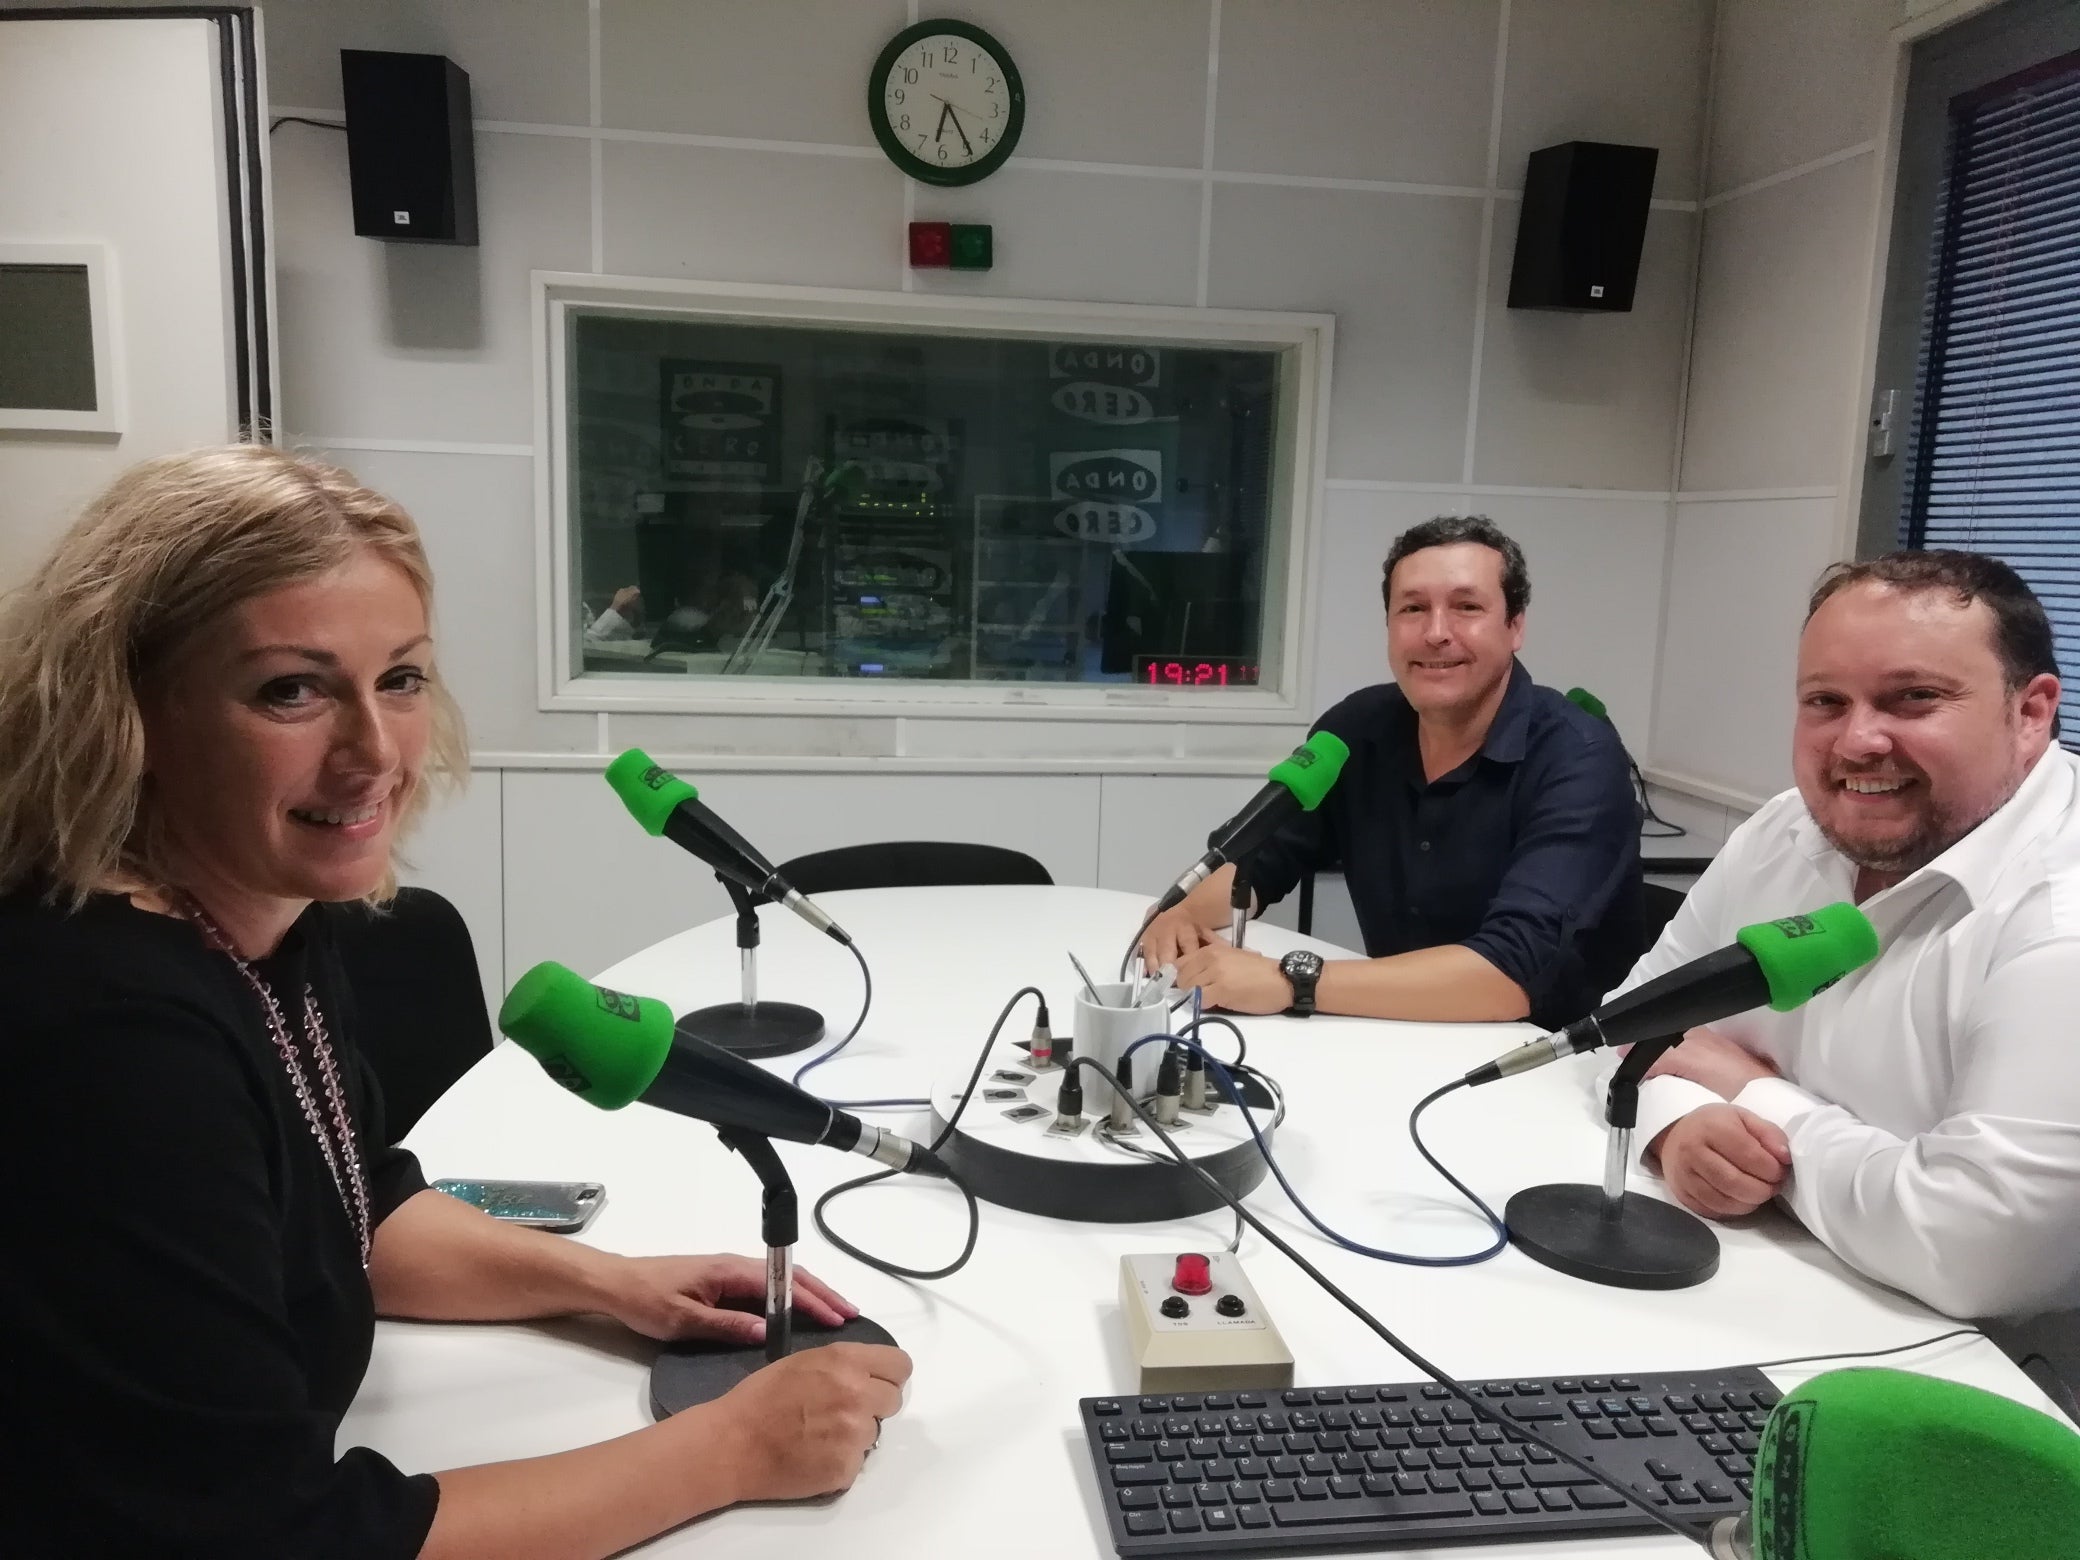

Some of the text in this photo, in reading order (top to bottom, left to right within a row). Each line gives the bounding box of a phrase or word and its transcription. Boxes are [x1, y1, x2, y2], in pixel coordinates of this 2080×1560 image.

[921, 51, 933, 69] 11
[943, 46, 958, 64] 12
[971, 58, 977, 74] 1
[903, 67, 919, 85] 10
[984, 76, 995, 94] 2
[895, 89, 905, 105] 9
[989, 103, 999, 118] 3
[900, 114, 911, 131] 8
[918, 133, 928, 150] 7
[979, 127, 990, 144] 4
[937, 144, 948, 160] 6
[1148, 661, 1229, 686] 19:21
[1160, 1440, 1169, 1448] Q
[1208, 1459, 1217, 1467] S
[1398, 1472, 1409, 1480] M
[1200, 1483, 1209, 1491] Z
[1234, 1481, 1242, 1489] X
